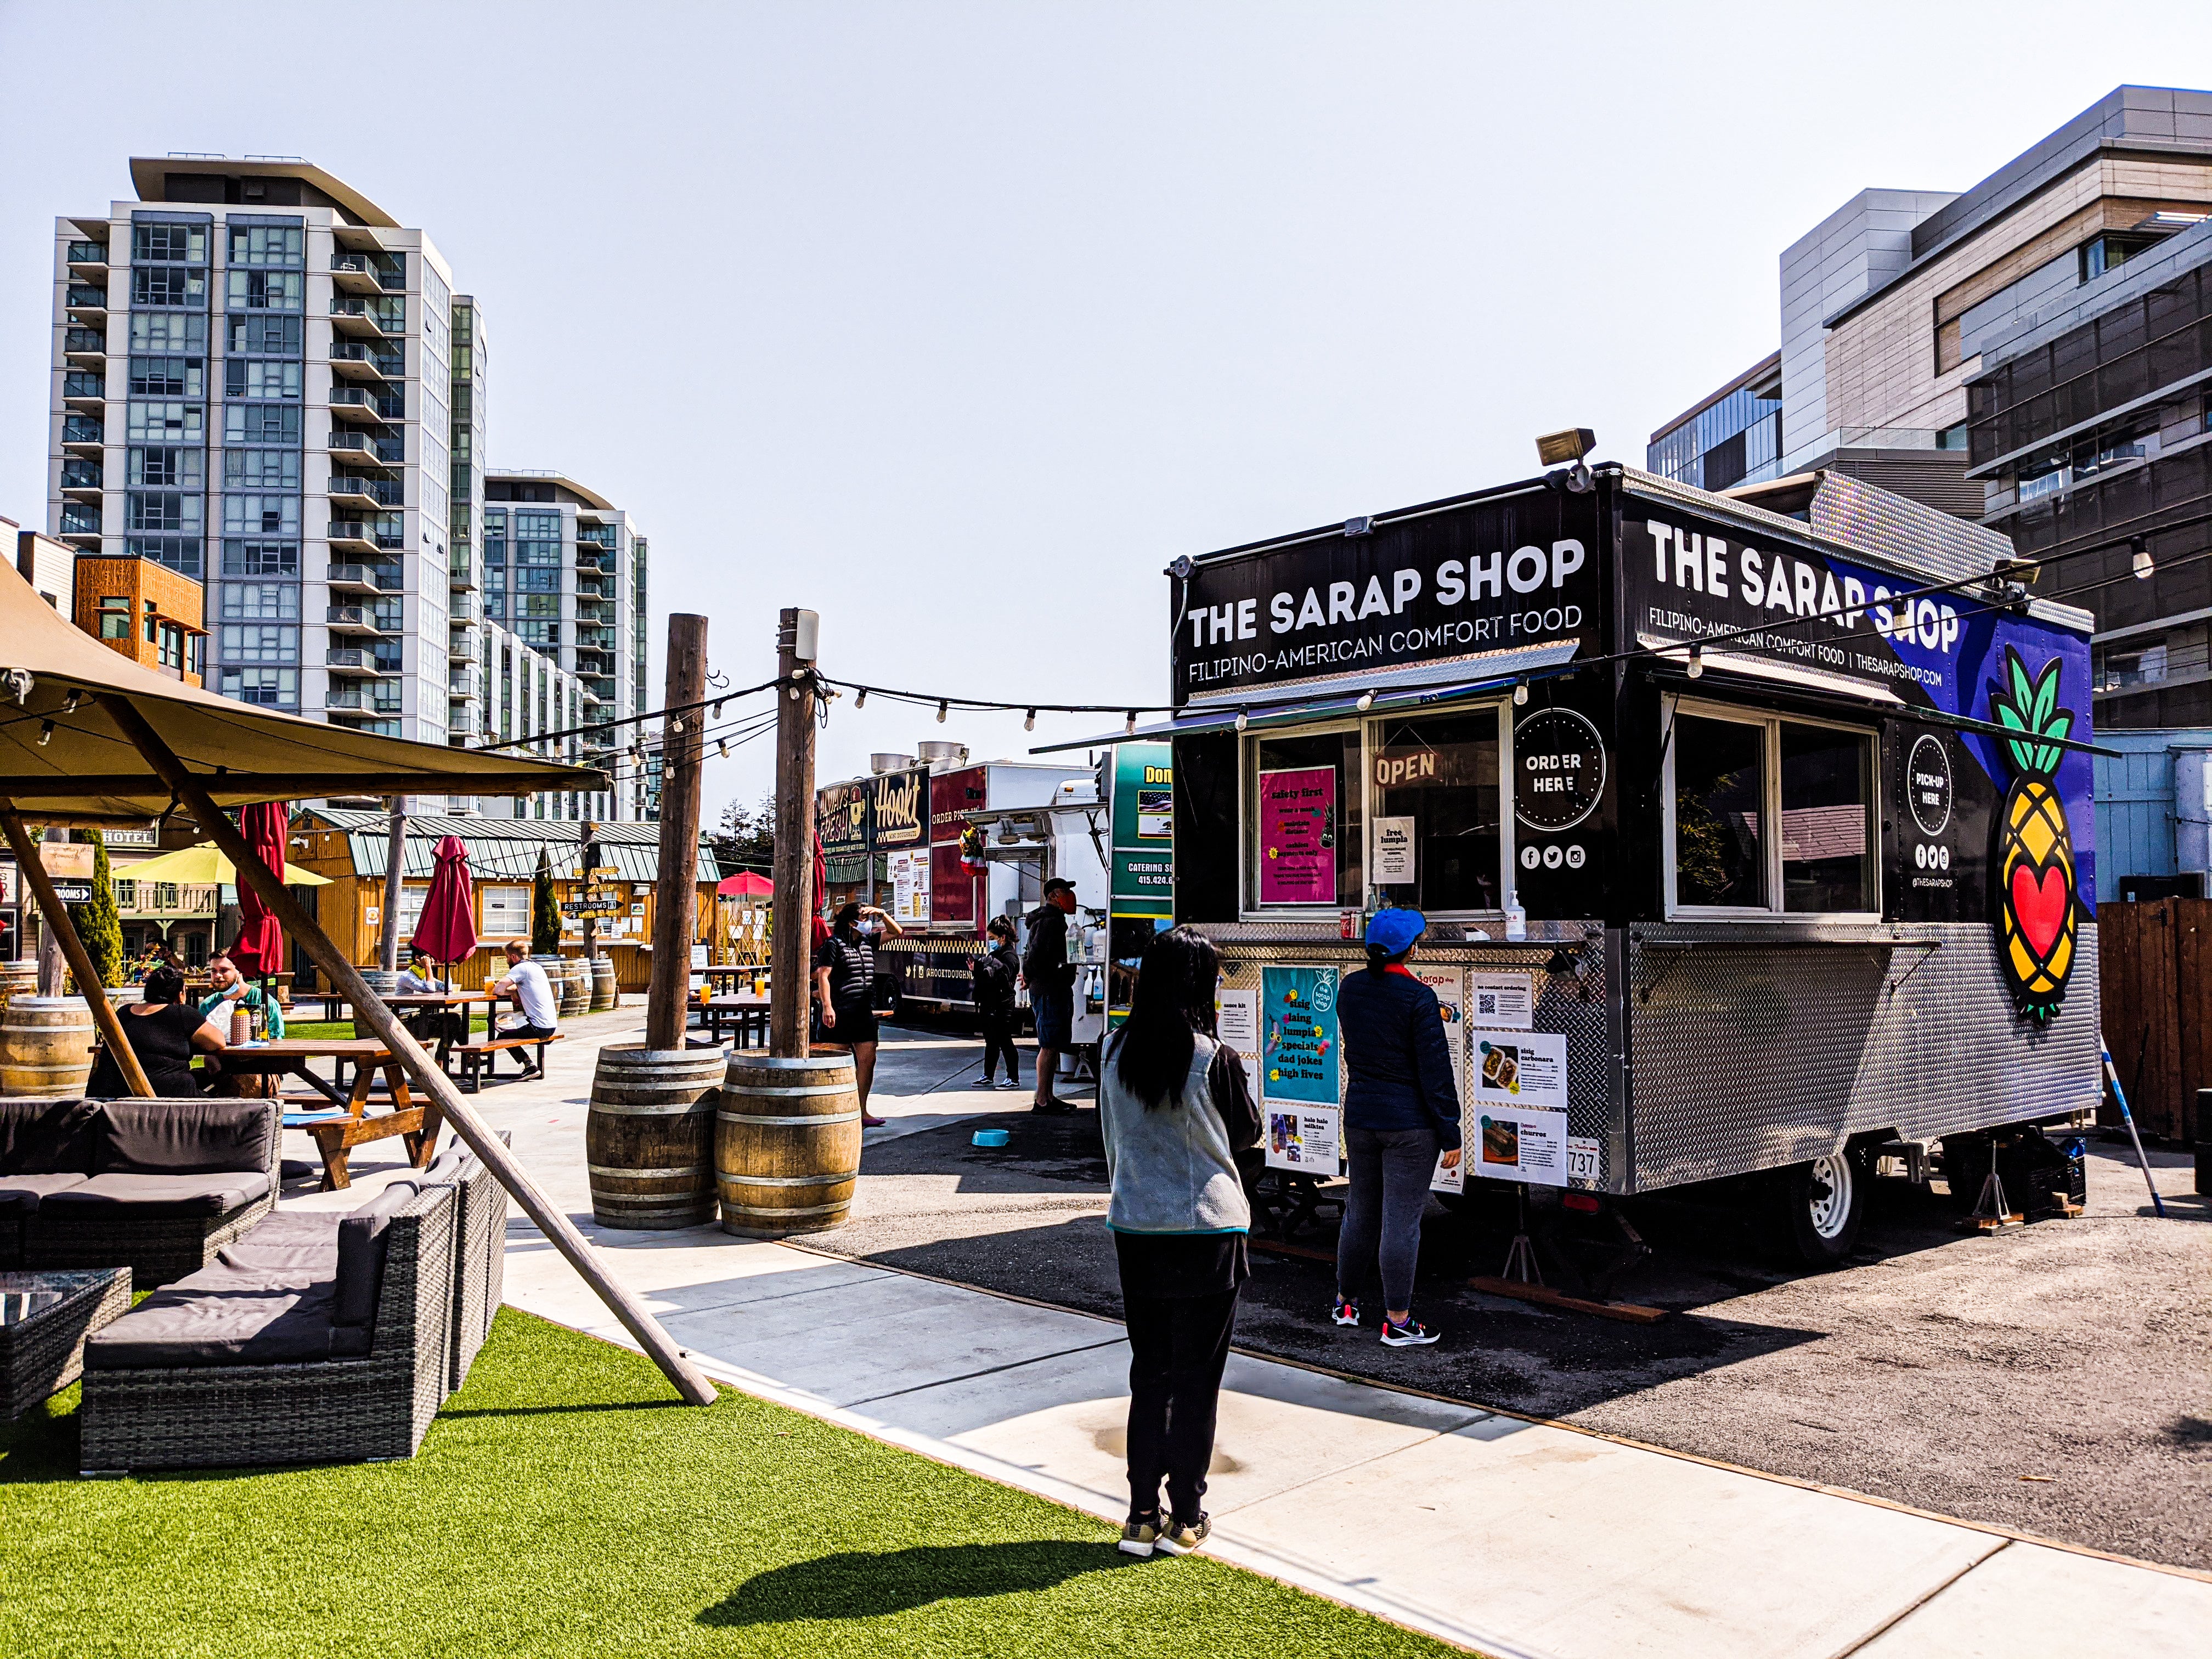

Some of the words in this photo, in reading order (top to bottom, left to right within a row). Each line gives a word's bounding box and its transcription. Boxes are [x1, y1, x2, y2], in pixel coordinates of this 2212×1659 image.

[1647, 519, 1728, 598] THE
[1741, 548, 1865, 629] SARAP
[1874, 585, 1958, 653] SHOP
[1188, 598, 1256, 647] THE
[1270, 568, 1421, 634] SARAP
[1436, 539, 1584, 605] SHOP
[1189, 634, 1382, 682] FILIPINO-AMERICAN
[1390, 616, 1503, 653] COMFORT
[1510, 605, 1582, 636] FOOD
[1650, 607, 1764, 648] FILIPINO-AMERICAN
[1767, 634, 1816, 659] COMFORT
[1818, 645, 1844, 665] FOOD
[1856, 653, 1942, 686] THESARAPSHOP.COM
[1526, 754, 1581, 770] ORDER
[1146, 766, 1172, 783] Don
[1377, 754, 1434, 784] OPEN
[1534, 777, 1573, 792] HERE
[1916, 773, 1944, 788] PICK-UP
[1271, 789, 1299, 800] safety
[1302, 787, 1323, 797] first
[1922, 792, 1940, 805] HERE
[820, 788, 849, 820] ALWAYS
[874, 773, 921, 828] Hookt
[932, 812, 952, 824] ORDER
[820, 808, 848, 843] FRESH
[103, 833, 151, 843] HOTEL
[1128, 863, 1163, 872] CATERING
[1912, 878, 1953, 888] @THESARAPSHOP
[55, 889, 81, 899] ROOMS
[1419, 976, 1444, 986] sarap
[1290, 999, 1310, 1011] sisig
[1289, 1014, 1311, 1024] laing
[1284, 1026, 1316, 1039] lumpia
[1282, 1042, 1318, 1052] specials
[1278, 1054, 1295, 1064] dad
[1297, 1055, 1323, 1066] jokes
[1278, 1068, 1299, 1079] high
[1301, 1069, 1323, 1080] fives
